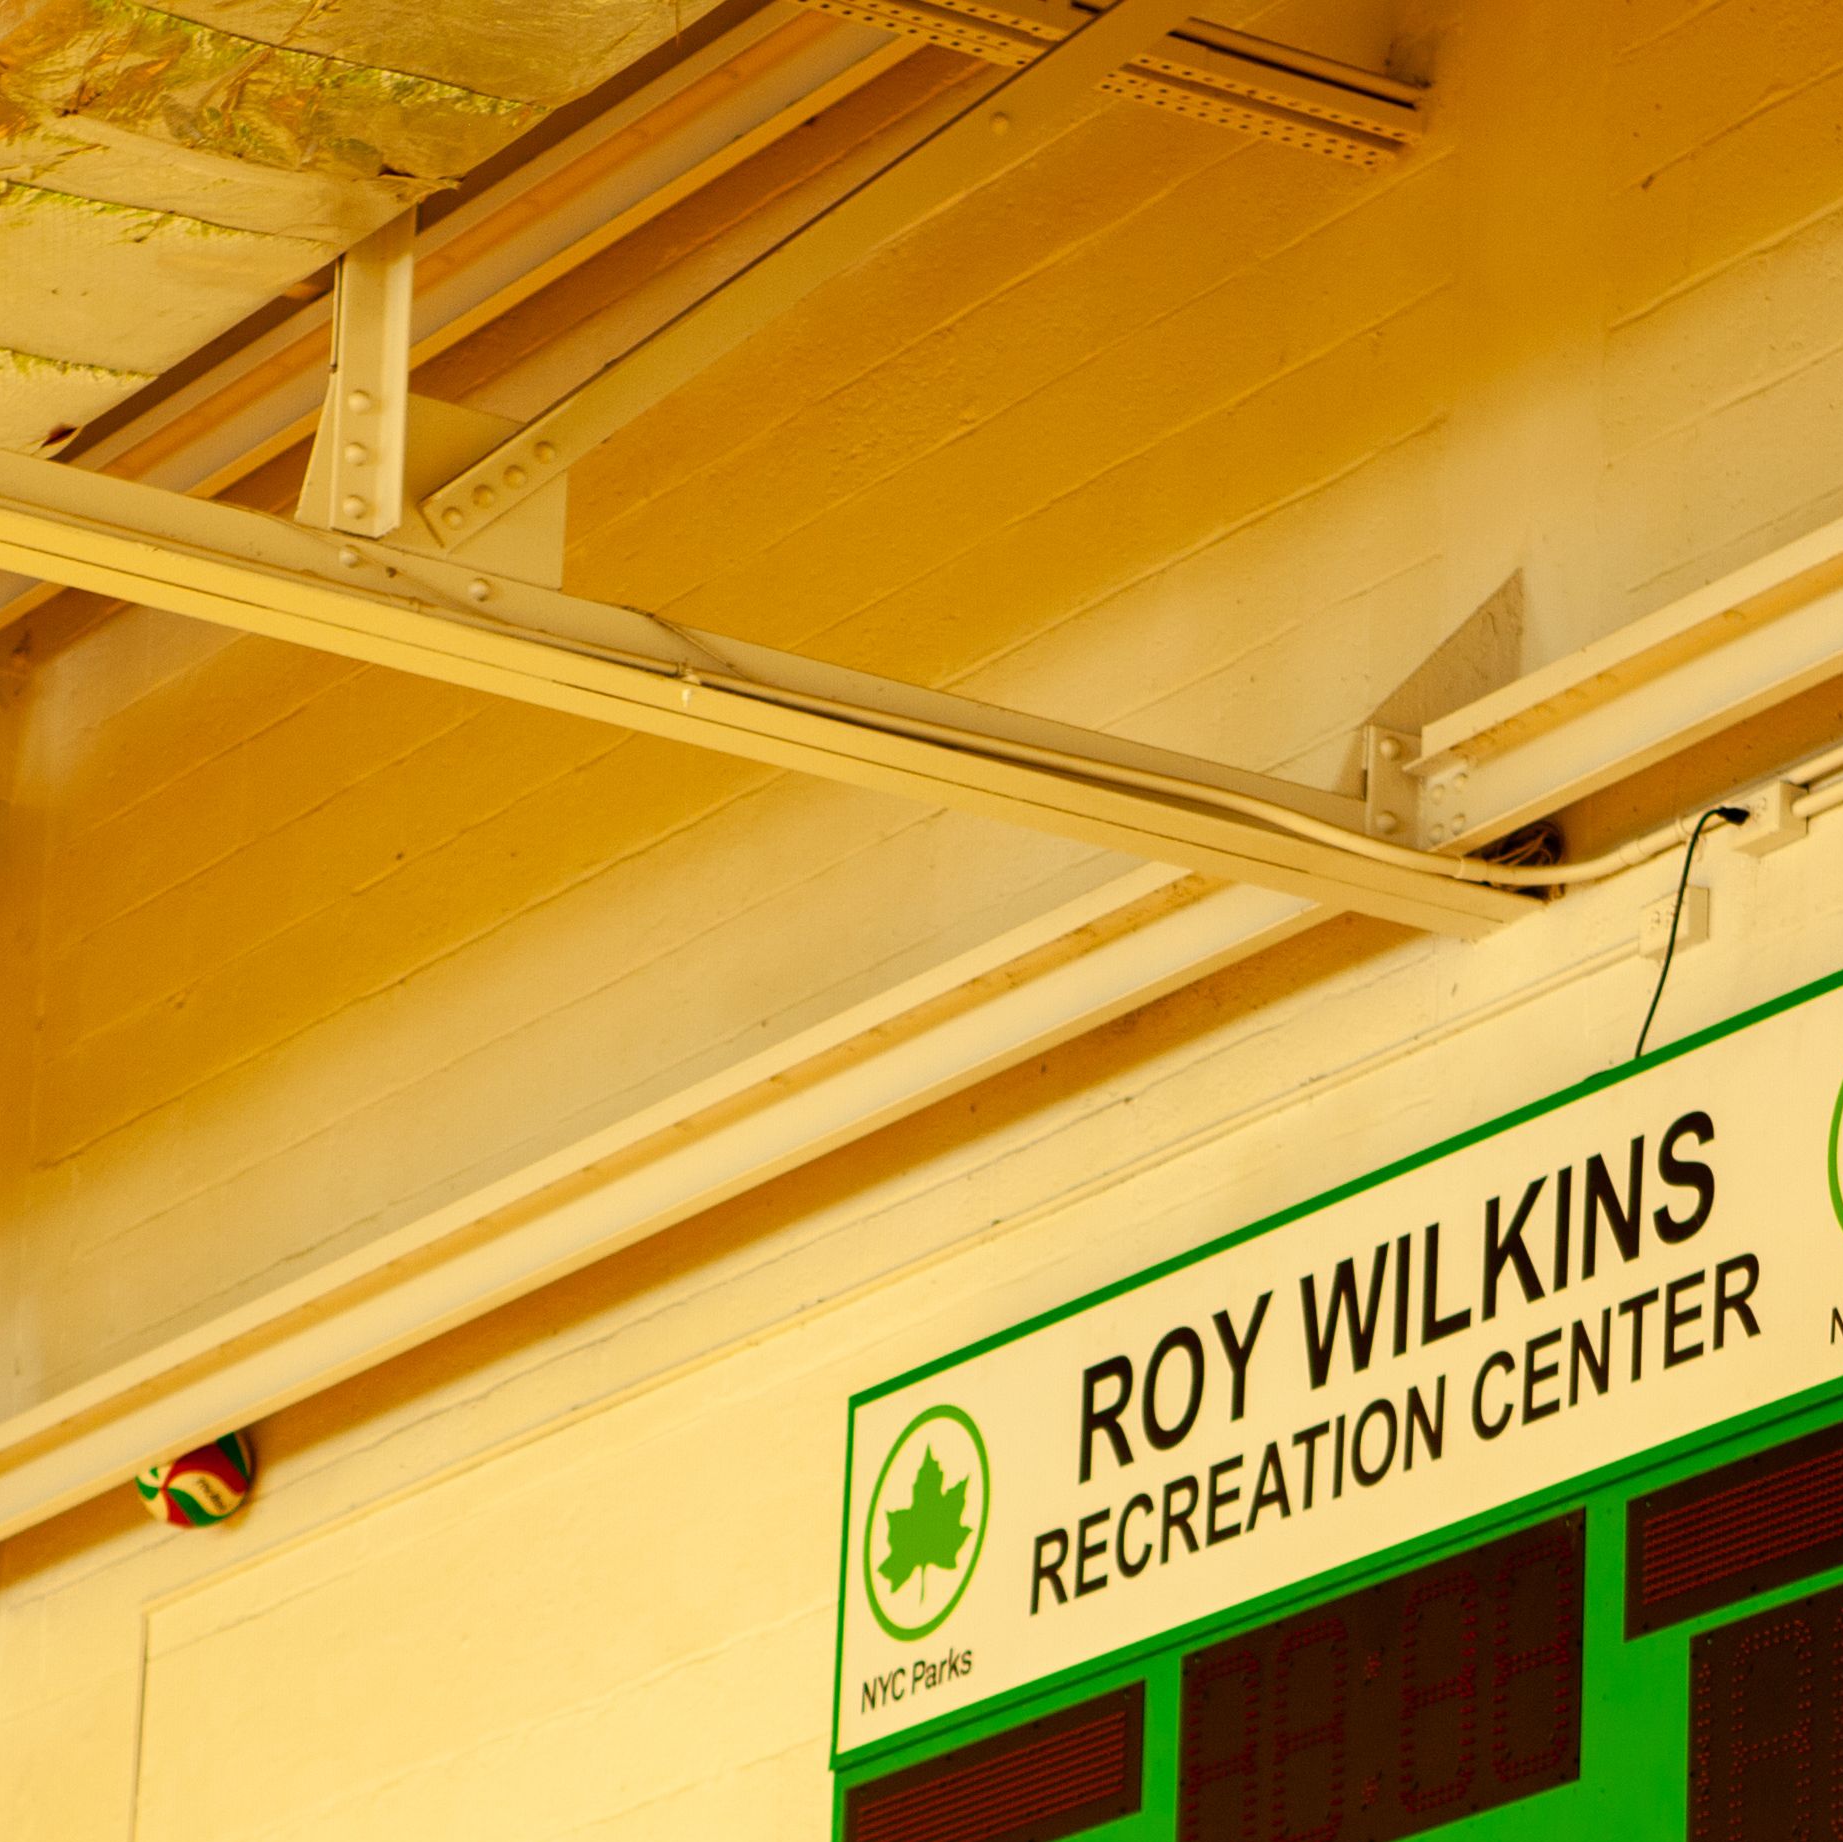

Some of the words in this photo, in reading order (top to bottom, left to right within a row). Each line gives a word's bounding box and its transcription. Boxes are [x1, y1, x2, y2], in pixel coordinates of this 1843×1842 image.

[1030, 1373, 1448, 1616] RECREATION
[1470, 1251, 1763, 1443] CENTER
[1077, 1289, 1274, 1485] ROY
[1299, 1109, 1716, 1391] WILKINS
[861, 1667, 906, 1714] NYC
[911, 1646, 973, 1695] Parks
